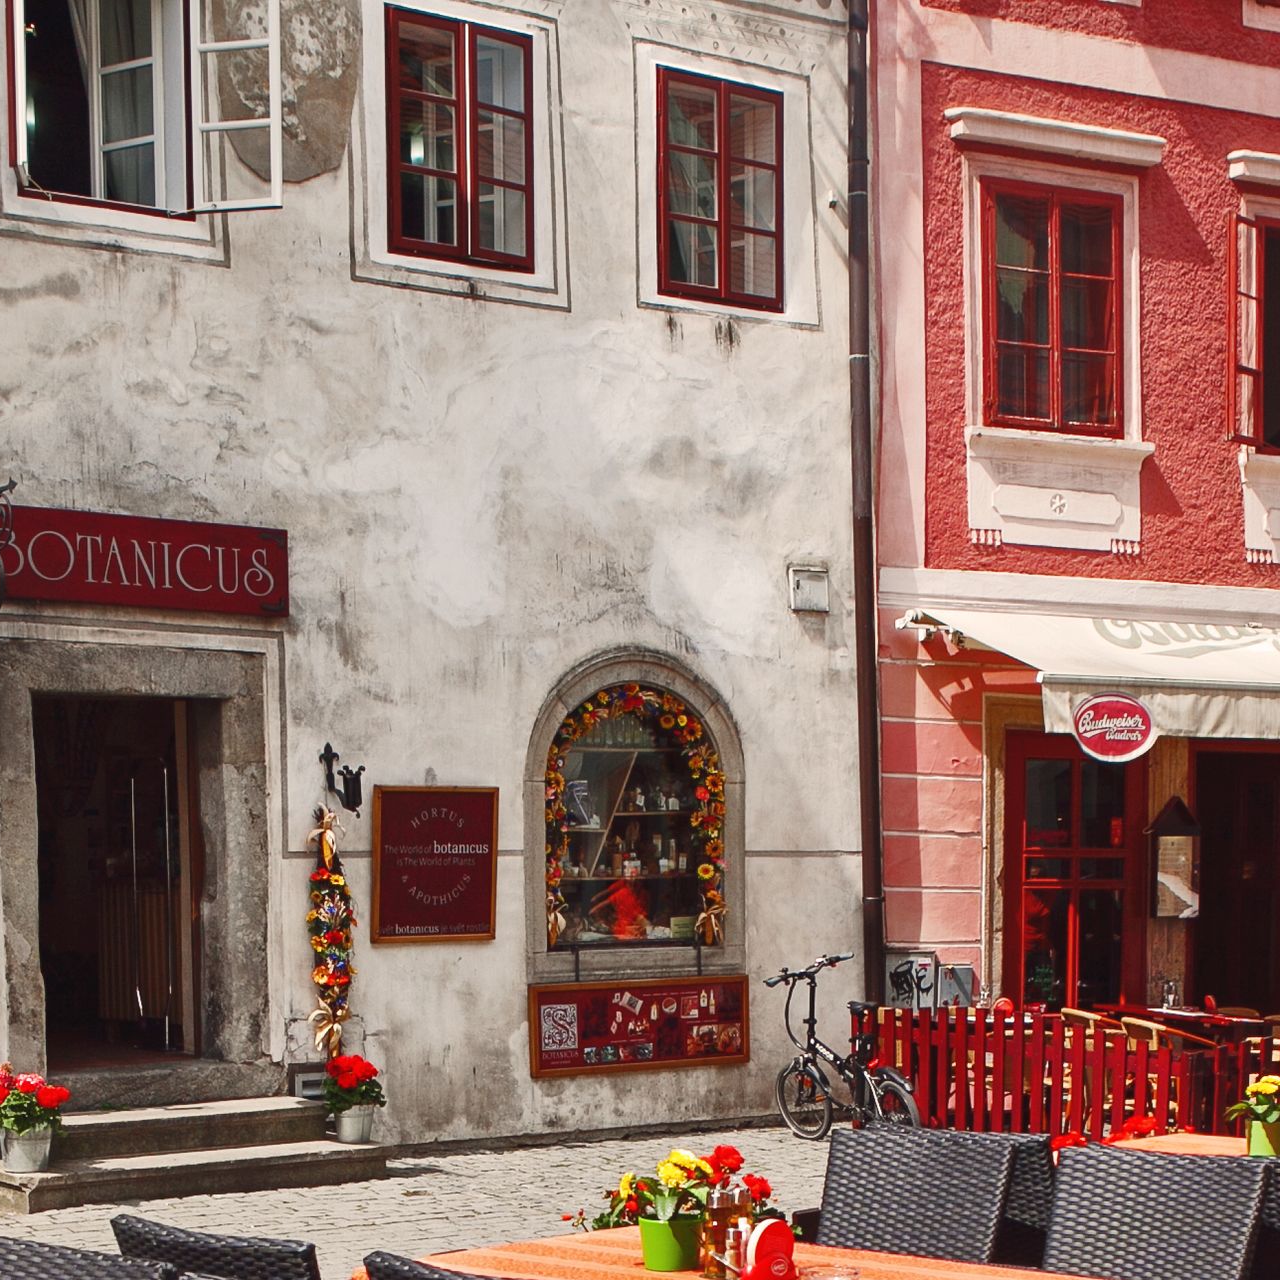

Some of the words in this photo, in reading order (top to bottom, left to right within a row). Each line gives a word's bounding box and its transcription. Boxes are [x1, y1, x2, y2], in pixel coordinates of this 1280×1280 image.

[1078, 710, 1146, 736] Budweiser
[411, 807, 465, 829] HORTUS
[433, 840, 489, 854] botanicus
[409, 873, 471, 906] APOTHICUS
[395, 923, 440, 935] botanicus
